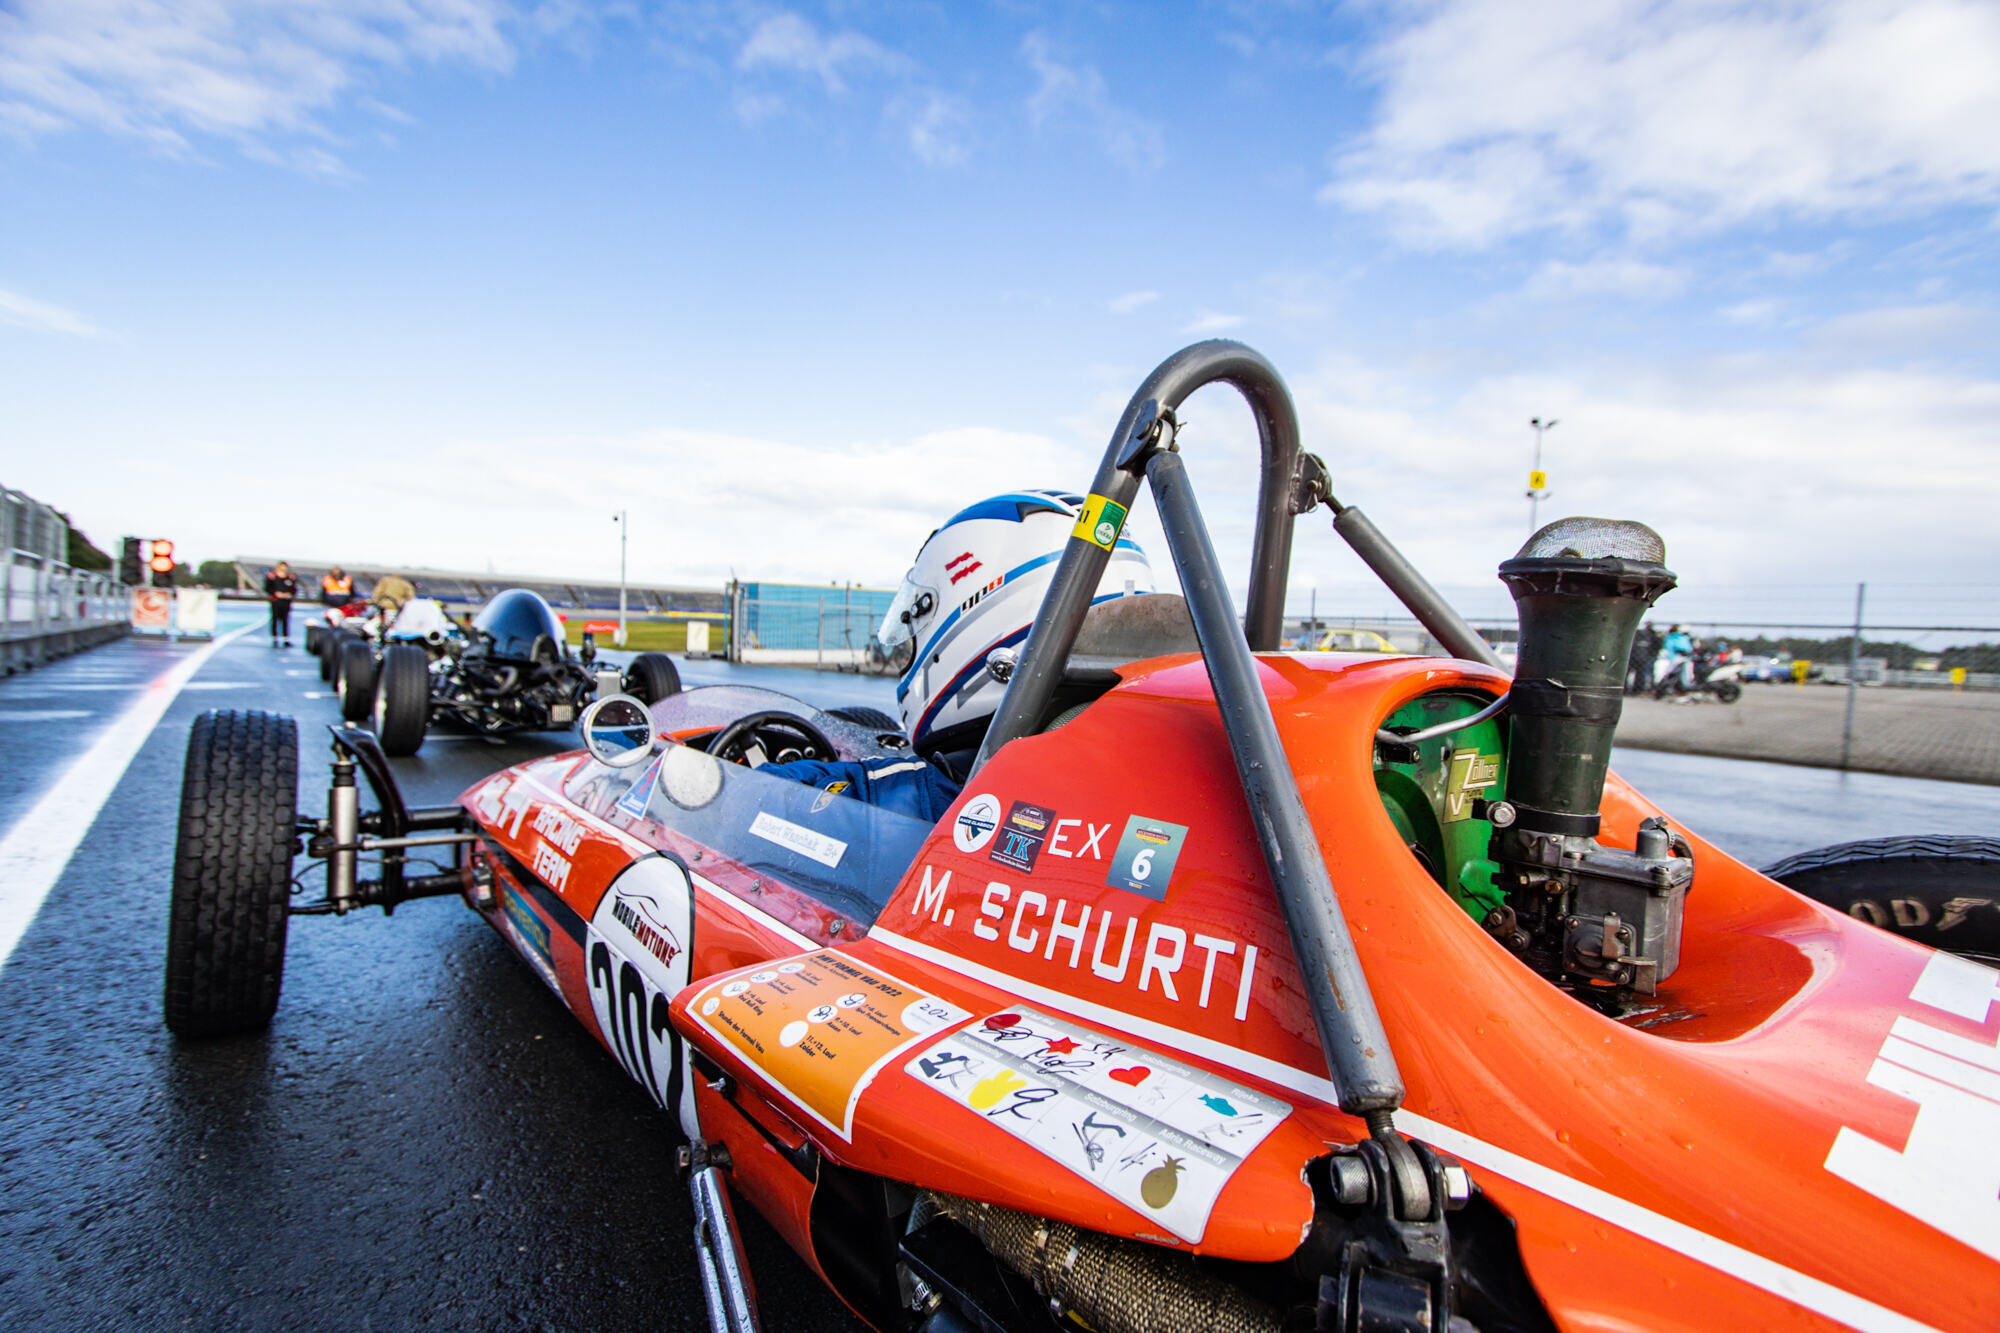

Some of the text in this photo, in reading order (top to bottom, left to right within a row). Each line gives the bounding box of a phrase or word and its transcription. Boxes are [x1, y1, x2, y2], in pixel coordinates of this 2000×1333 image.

[533, 804, 586, 857] RACING
[1003, 832, 1035, 861] TK
[1048, 819, 1111, 860] EX
[533, 839, 572, 893] TEAM
[1131, 848, 1156, 881] 6
[911, 865, 1258, 1021] M. SCHURTI
[876, 984, 902, 996] 2022
